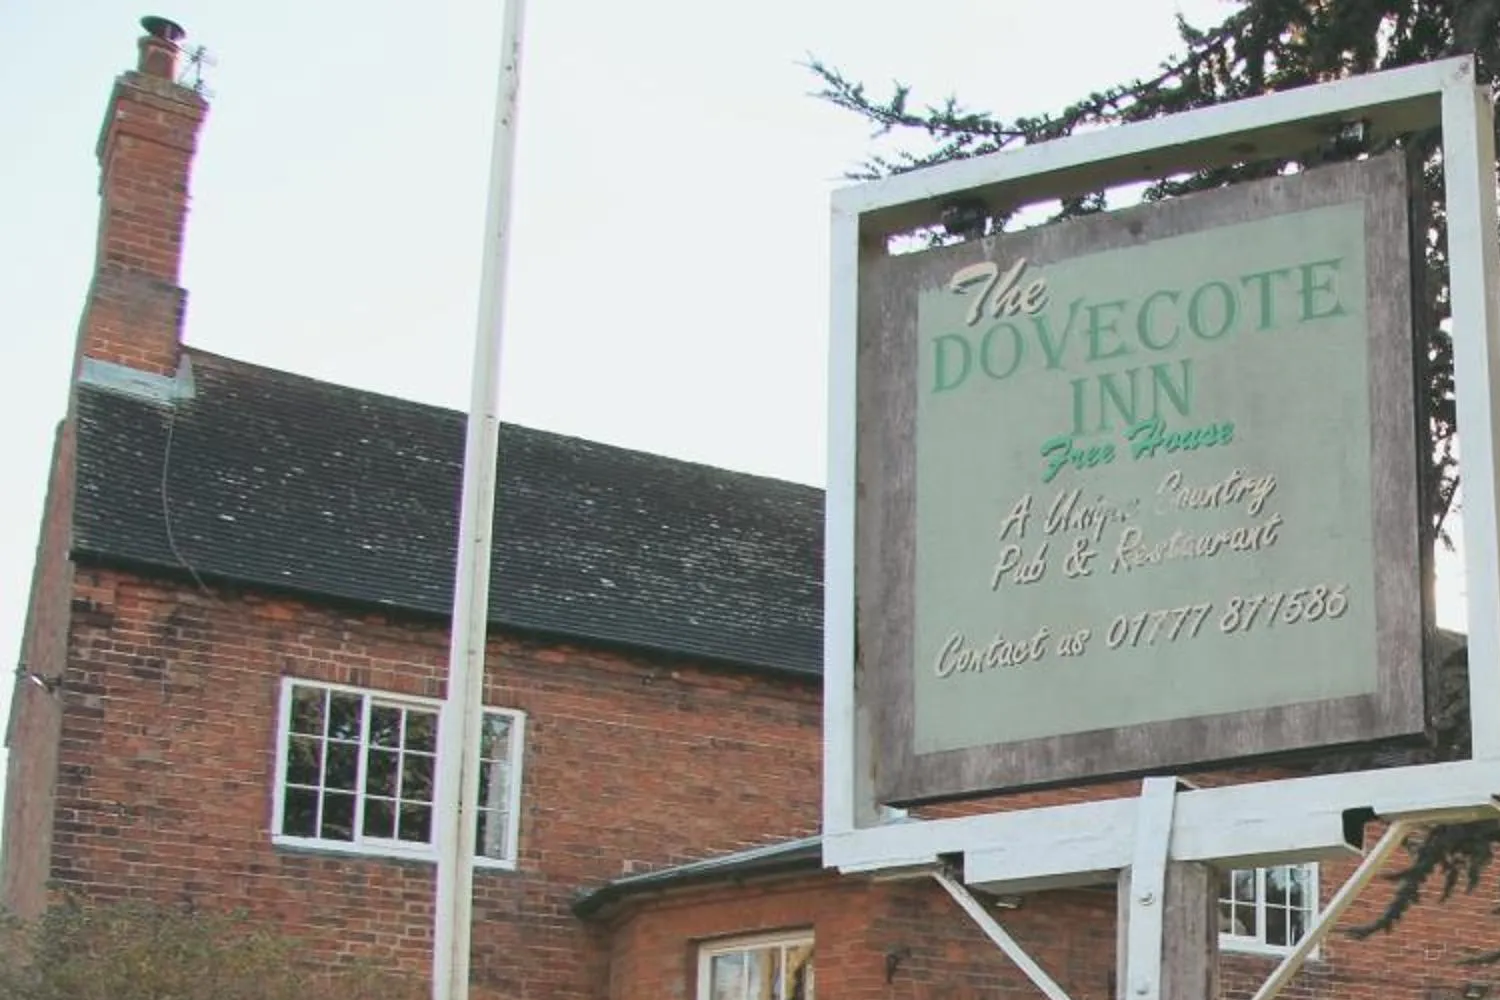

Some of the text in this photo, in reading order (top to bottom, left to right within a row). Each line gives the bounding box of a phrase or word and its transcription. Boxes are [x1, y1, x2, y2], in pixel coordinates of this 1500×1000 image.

[931, 259, 1348, 393] DOVECOTE
[951, 259, 1048, 327] The
[1069, 357, 1195, 437] INN
[1040, 417, 1236, 482] Free House
[991, 515, 1283, 591] Pub & Restaurant
[998, 494, 1032, 541] A
[1044, 488, 1140, 542] Uniq
[935, 585, 1349, 678] Contact us 01777 871586
